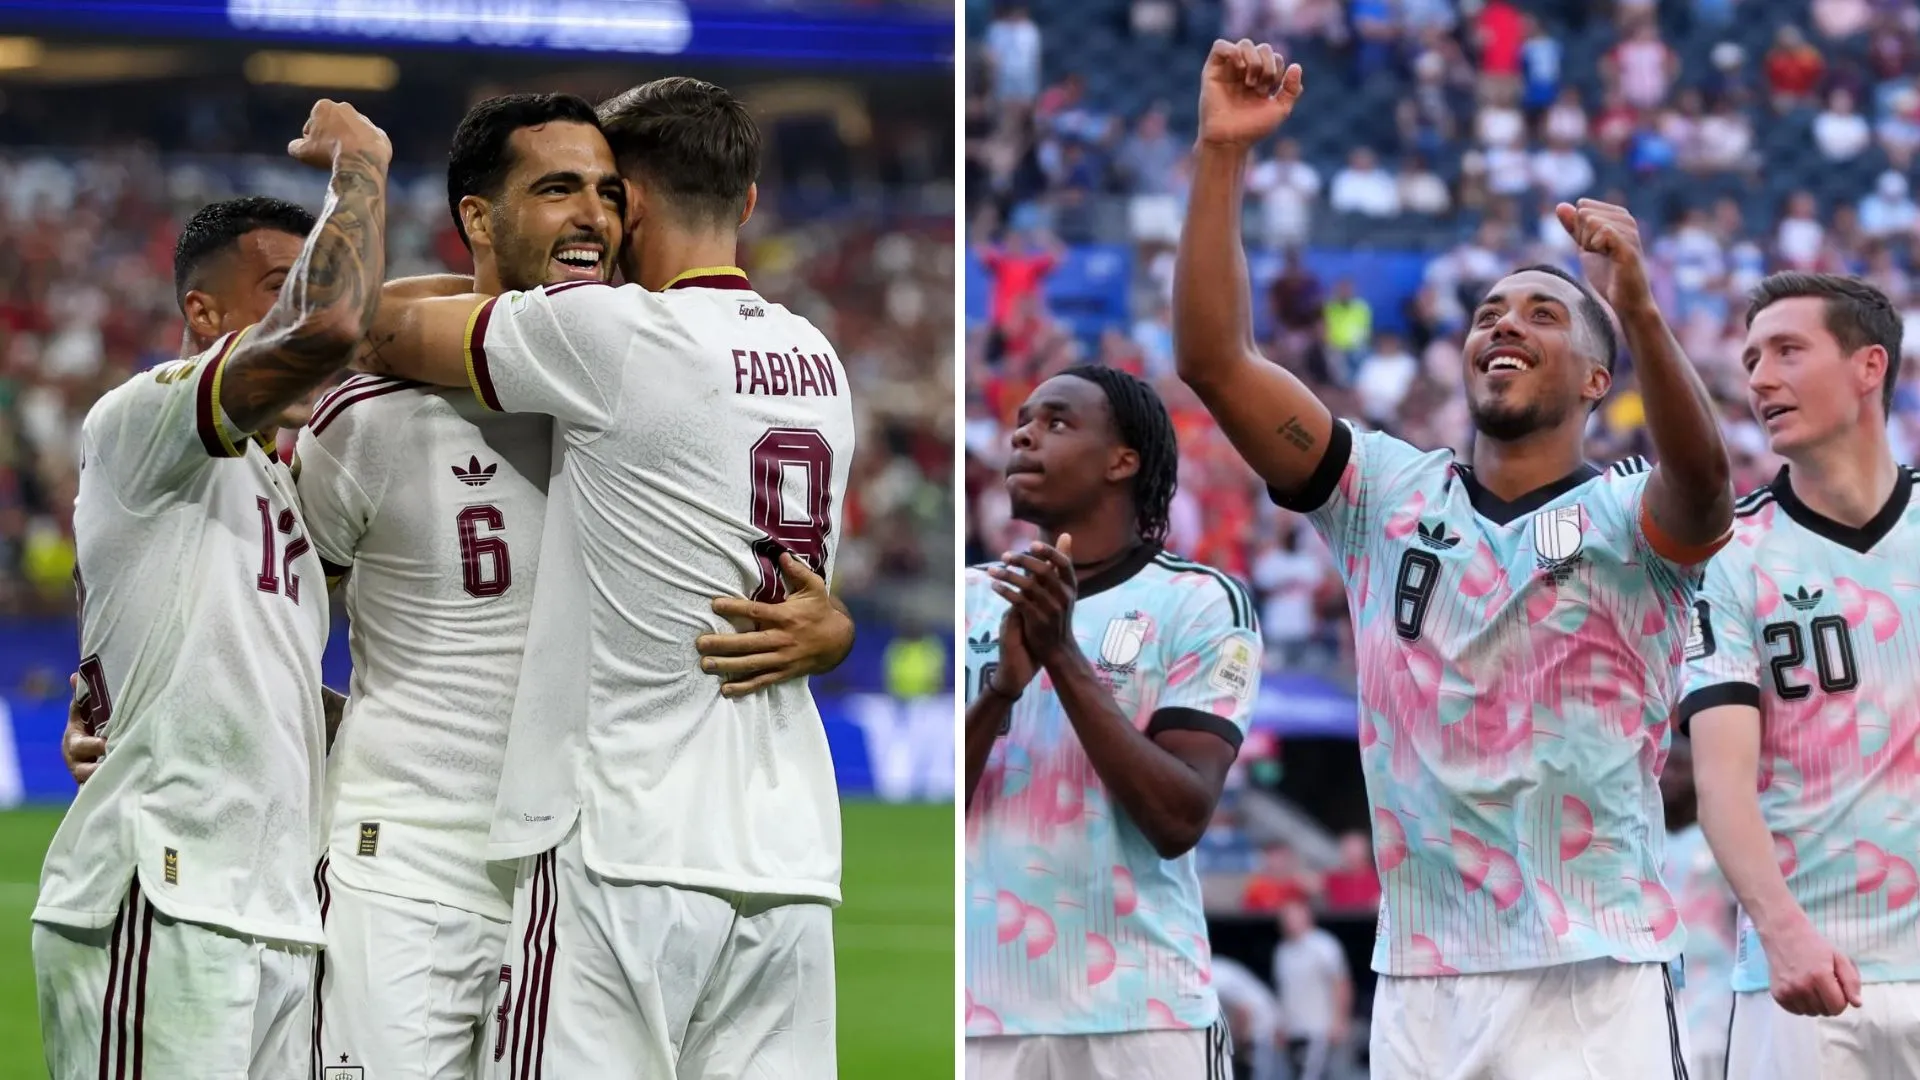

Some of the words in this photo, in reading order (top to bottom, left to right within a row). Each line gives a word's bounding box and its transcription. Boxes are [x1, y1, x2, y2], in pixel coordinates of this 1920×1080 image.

[731, 346, 838, 397] FABIÁN
[256, 494, 310, 606] 12
[456, 504, 512, 598] 6
[1395, 547, 1442, 641] 8
[1763, 615, 1859, 701] 20
